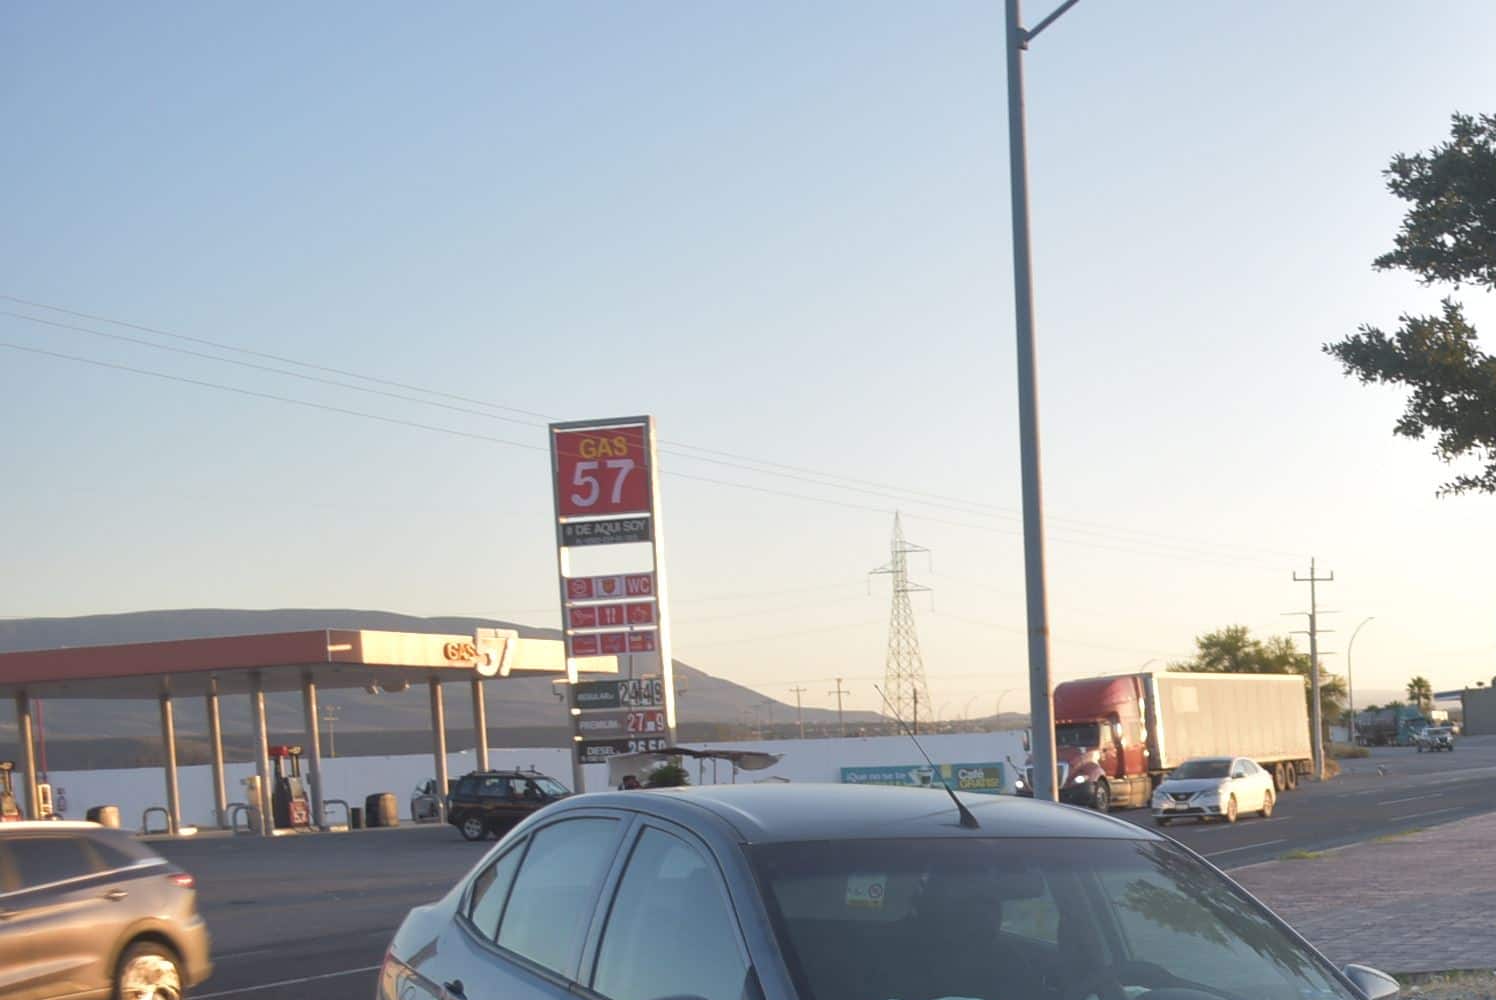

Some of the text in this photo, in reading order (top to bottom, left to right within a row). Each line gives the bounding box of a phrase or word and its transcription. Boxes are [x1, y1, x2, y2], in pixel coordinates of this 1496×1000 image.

[579, 436, 628, 459] GAS
[571, 459, 635, 507] 57
[623, 520, 646, 532] SOY
[627, 577, 649, 593] WC
[475, 628, 519, 677] 57
